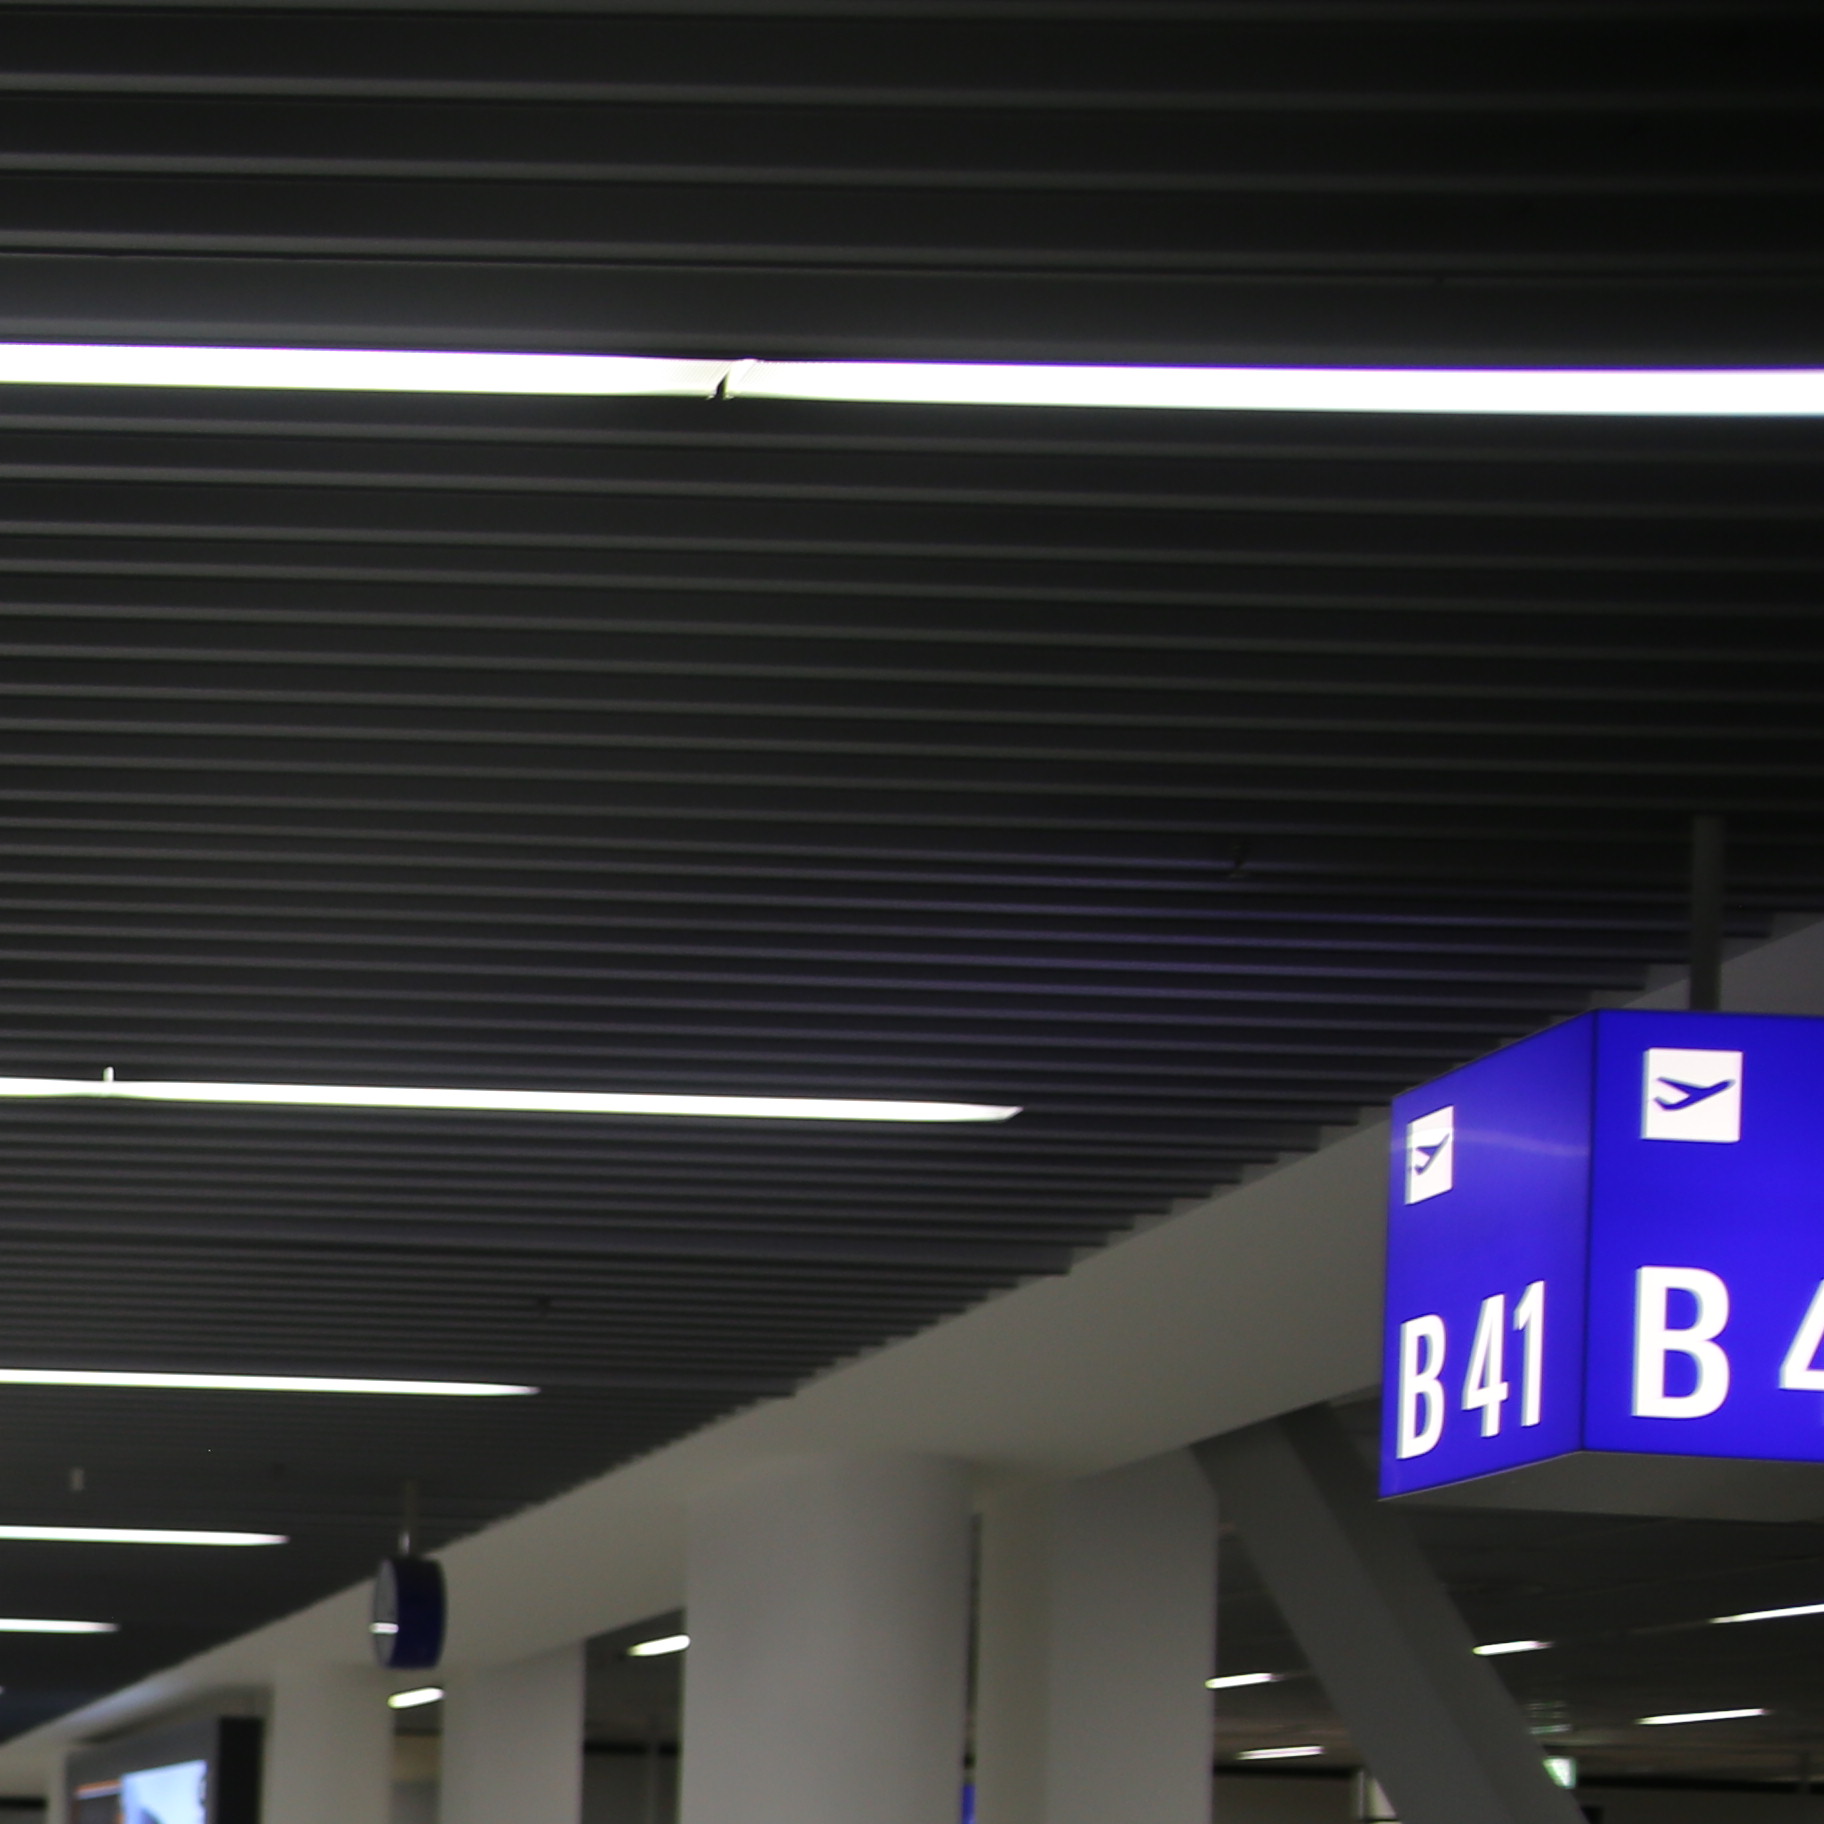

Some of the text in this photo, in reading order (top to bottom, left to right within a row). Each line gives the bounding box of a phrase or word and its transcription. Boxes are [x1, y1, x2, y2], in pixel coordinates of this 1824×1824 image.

[1396, 1280, 1545, 1460] B 41
[1632, 1266, 1731, 1419] B
